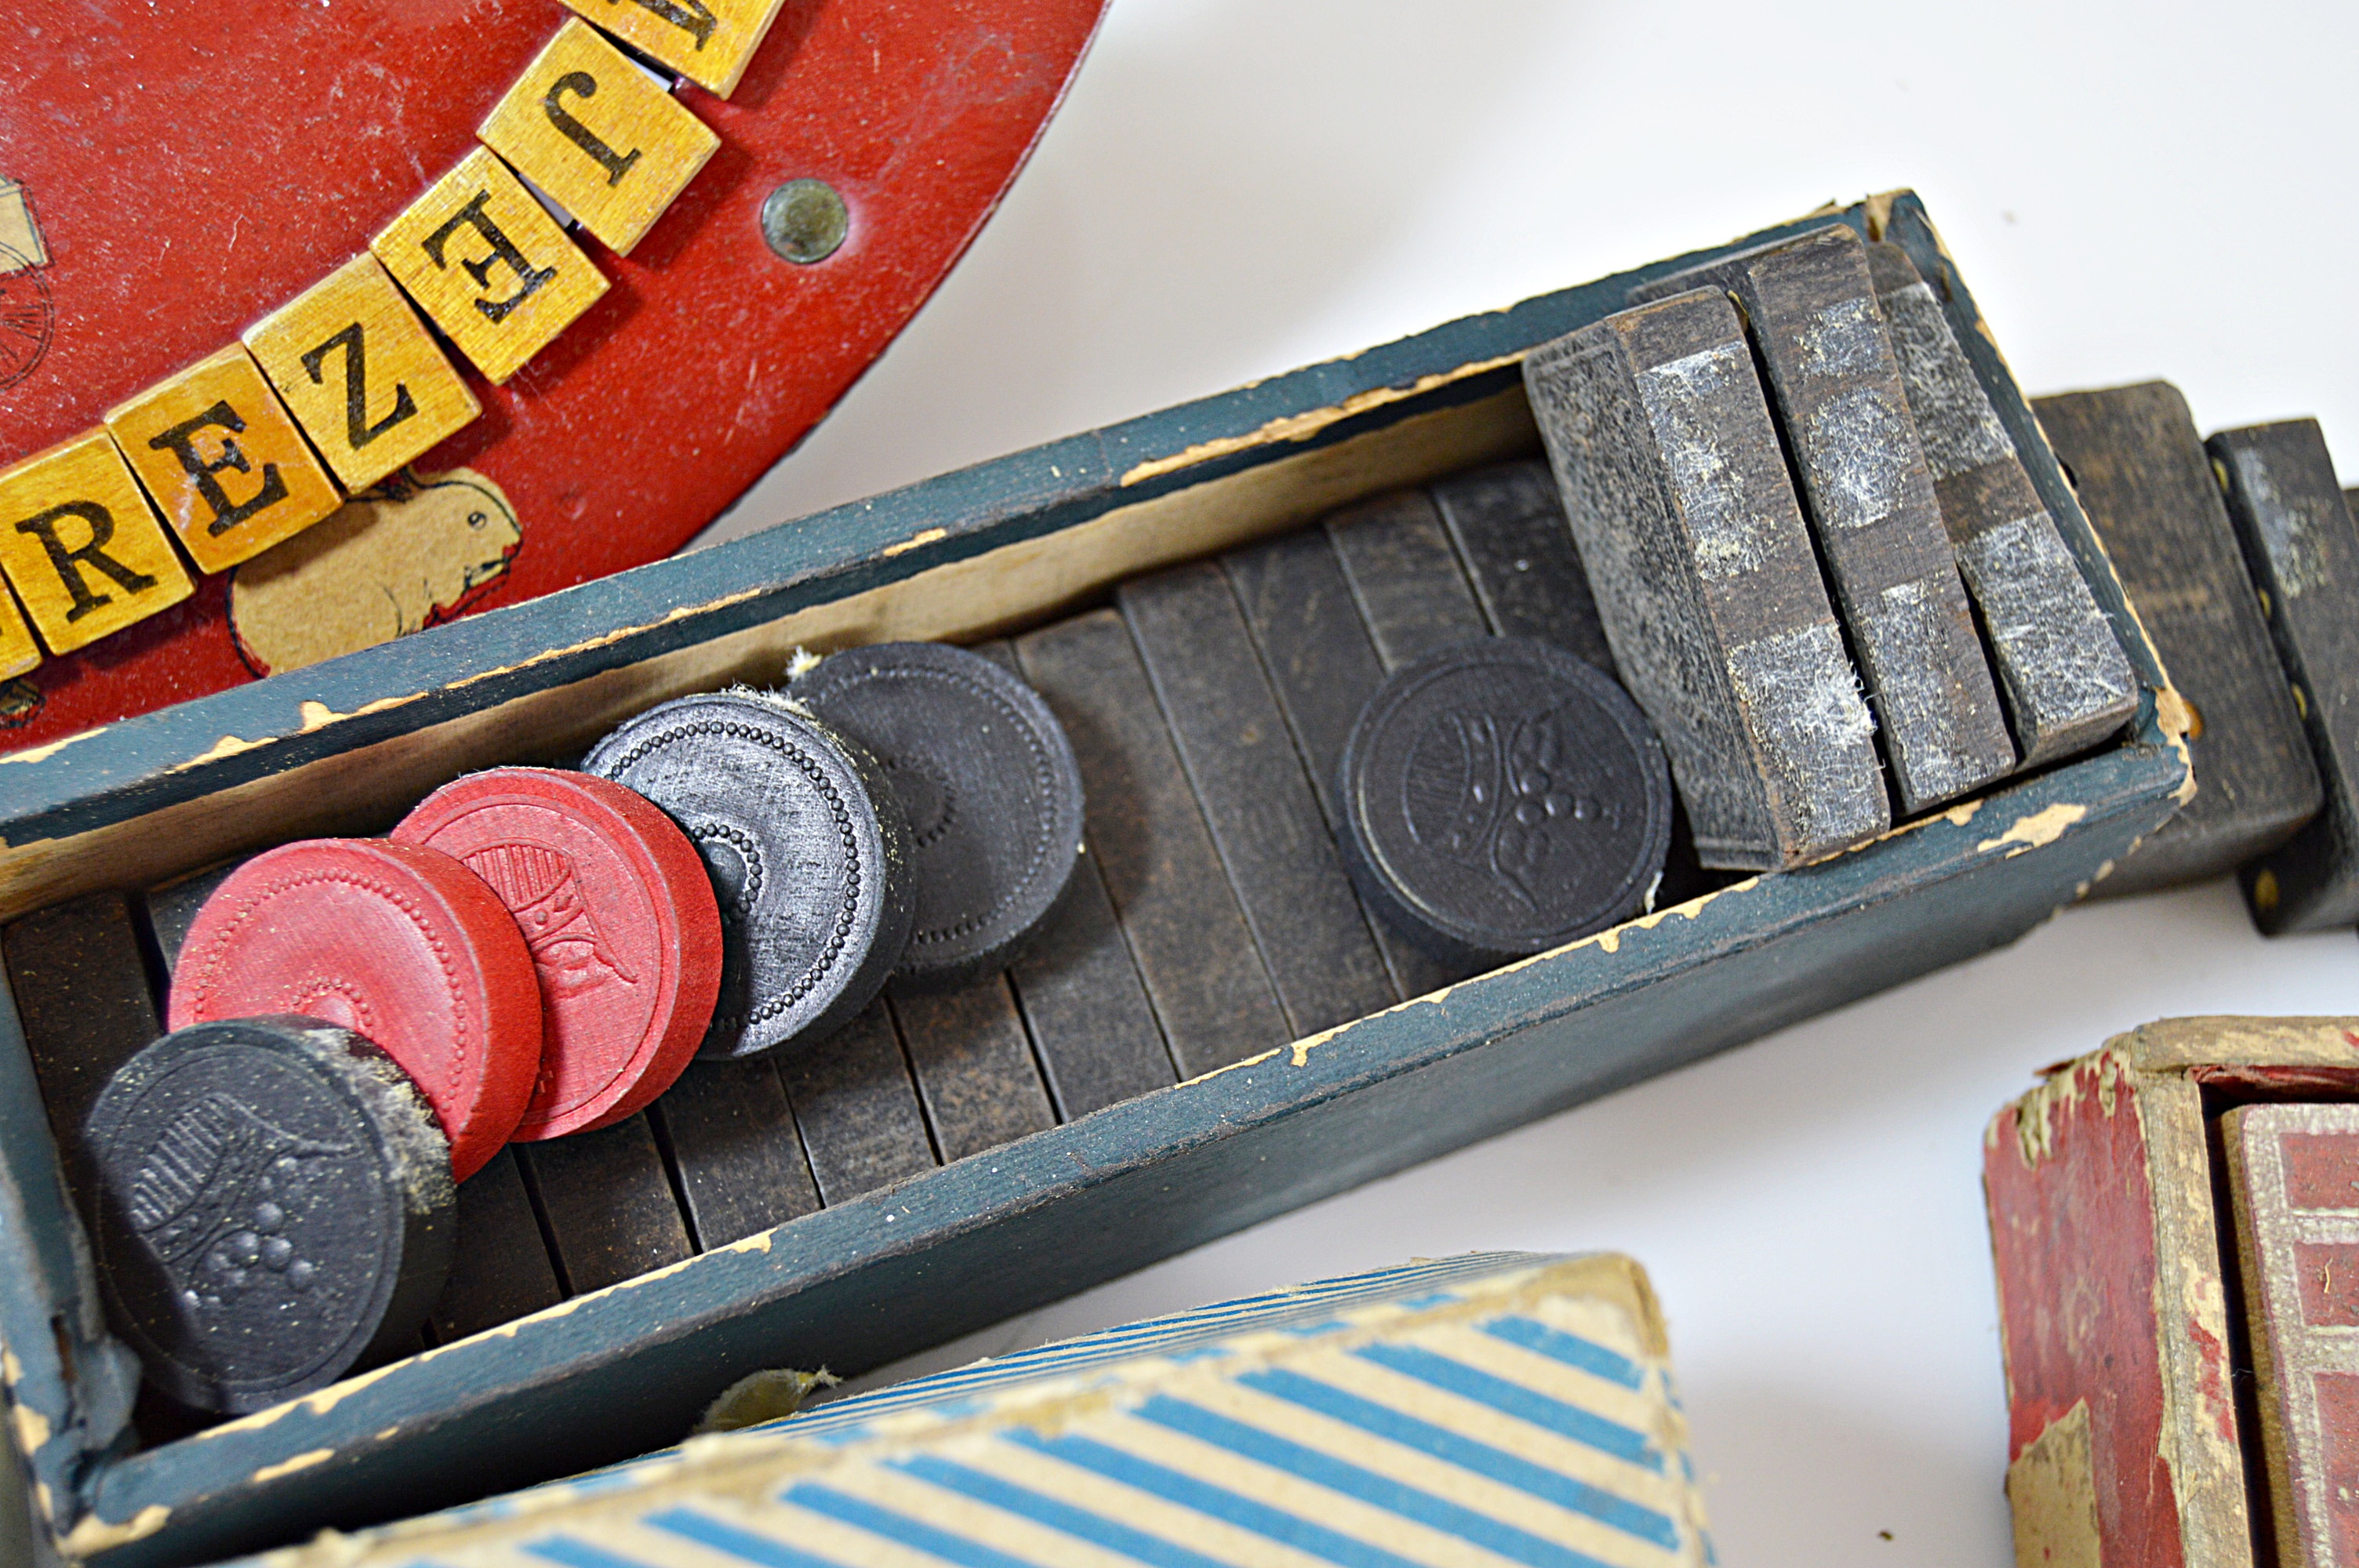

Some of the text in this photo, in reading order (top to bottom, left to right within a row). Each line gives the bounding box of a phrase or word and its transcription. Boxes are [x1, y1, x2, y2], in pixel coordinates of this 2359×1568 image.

[14, 71, 642, 623] R E Z E J
